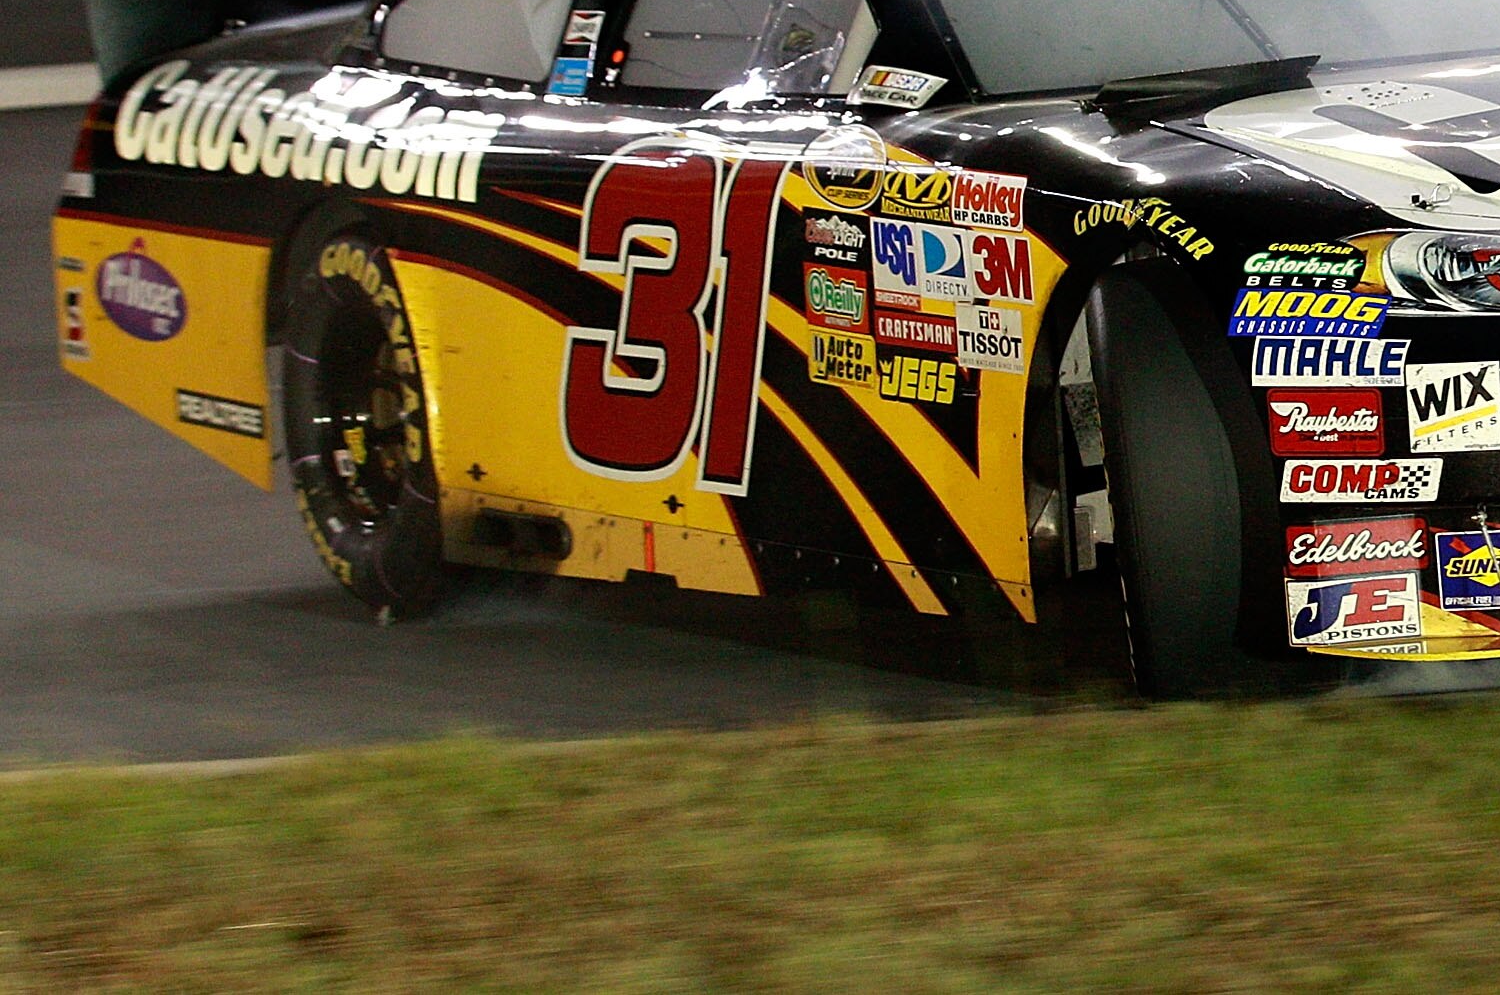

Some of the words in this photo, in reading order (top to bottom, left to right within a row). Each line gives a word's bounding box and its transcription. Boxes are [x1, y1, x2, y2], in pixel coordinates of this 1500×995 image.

[827, 188, 843, 197] CUP
[954, 176, 1022, 227] Holley
[924, 206, 950, 222] WEAR
[954, 210, 969, 221] HP
[971, 213, 1009, 226] CARBS
[814, 247, 858, 262] POLE
[873, 221, 917, 286] USG
[1267, 242, 1354, 255] GOODYEAR
[972, 234, 1033, 301] 3M
[1243, 252, 1363, 277] Gatorback
[1245, 276, 1347, 289] BELTS
[558, 135, 808, 497] 31
[1233, 290, 1389, 323] MOOG
[878, 317, 952, 346] CRAFTSMAN
[1236, 320, 1306, 335] CHASSIS
[1315, 321, 1370, 336] PARTS
[827, 336, 863, 359] Auto
[958, 331, 1022, 358] TISSOT
[1254, 337, 1408, 377] MAHLE
[826, 356, 873, 382] Meter
[881, 356, 956, 404] JEGS
[1409, 366, 1495, 422] WIX
[1269, 401, 1379, 435] Raybestos
[1412, 415, 1498, 449] FILTERS
[1289, 463, 1401, 494] COMP
[1363, 487, 1420, 500] CAMS
[1289, 529, 1426, 565] Edelbrock
[1293, 577, 1408, 640] JE
[1325, 623, 1418, 641] PISTONS
